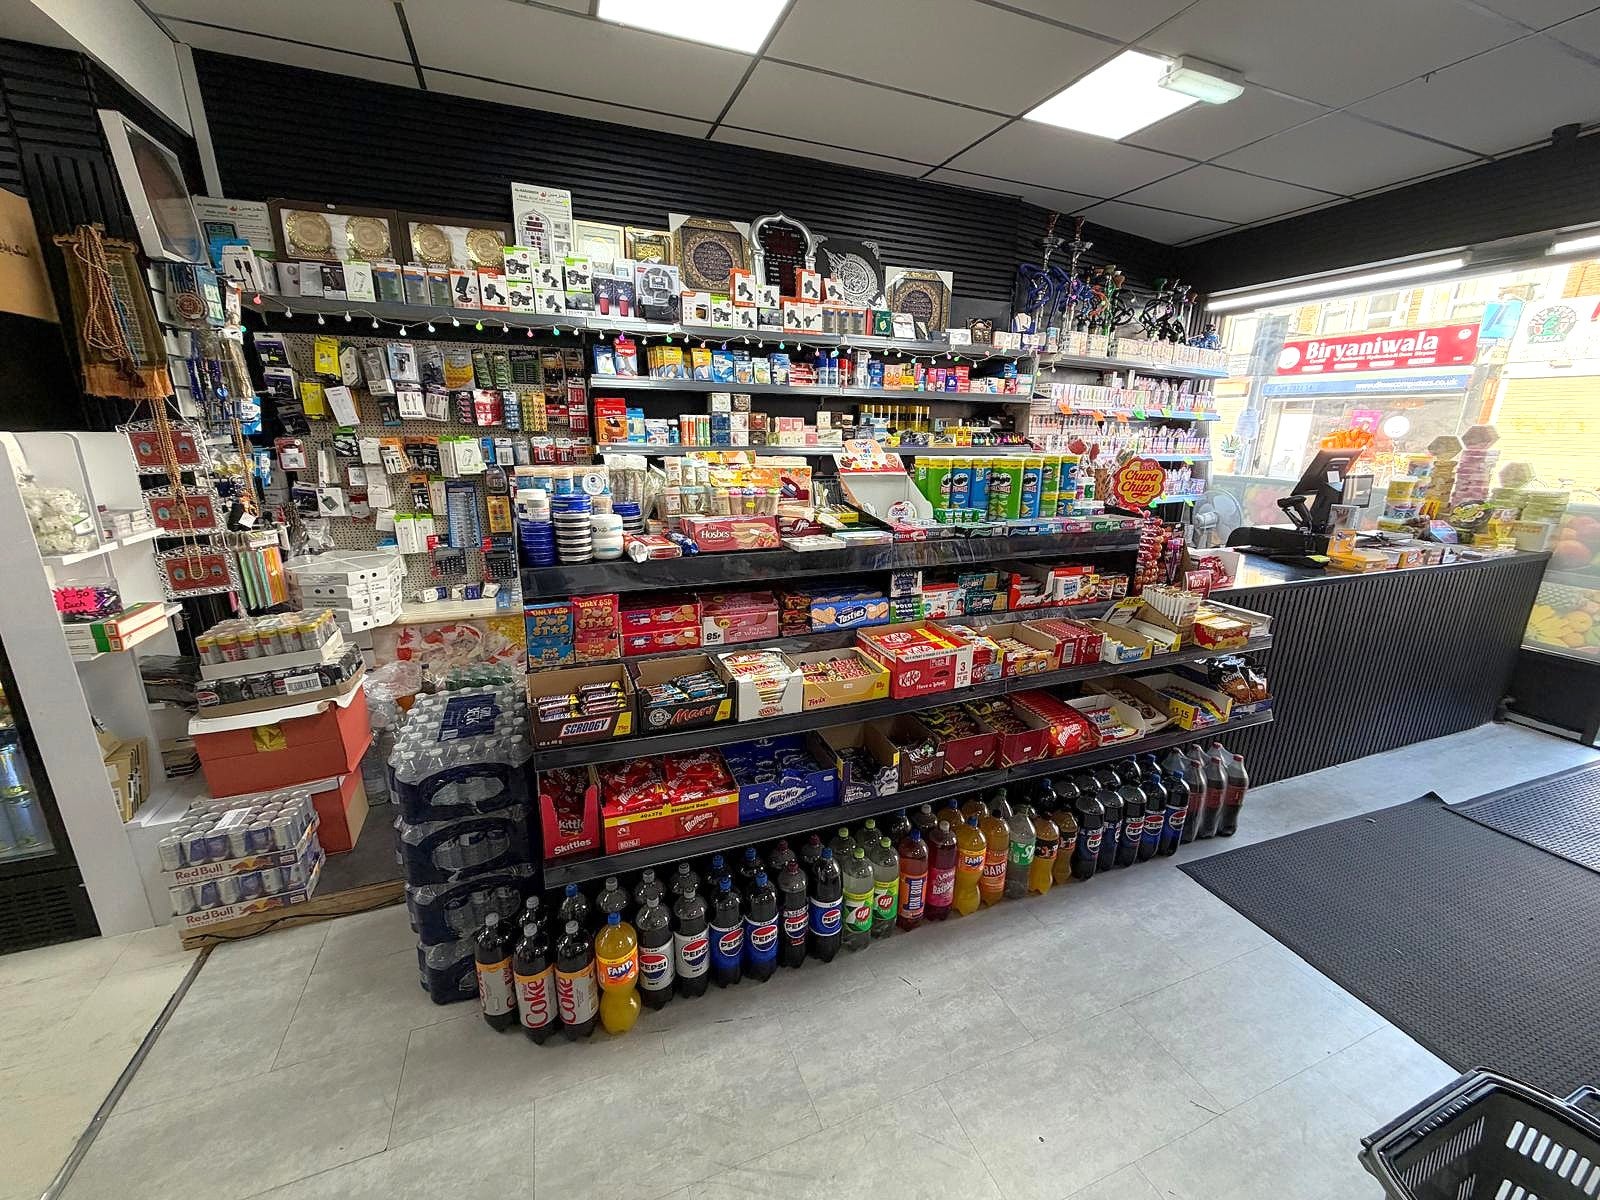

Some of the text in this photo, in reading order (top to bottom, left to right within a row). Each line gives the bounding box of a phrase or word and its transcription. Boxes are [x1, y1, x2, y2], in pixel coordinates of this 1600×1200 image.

[1305, 331, 1439, 362] Biryaniwala
[1125, 470, 1159, 483] Chupa
[1121, 481, 1155, 494] Chups
[701, 530, 730, 539] Hosbes
[837, 608, 865, 624] Tasties
[670, 704, 716, 725] Mars
[563, 718, 609, 735] SCROOGY
[554, 838, 592, 855] Skittles
[880, 896, 893, 908] up
[857, 907, 870, 920] up
[606, 960, 634, 976] FANTA
[525, 978, 548, 1029] Coke
[560, 978, 577, 1026] Coke
